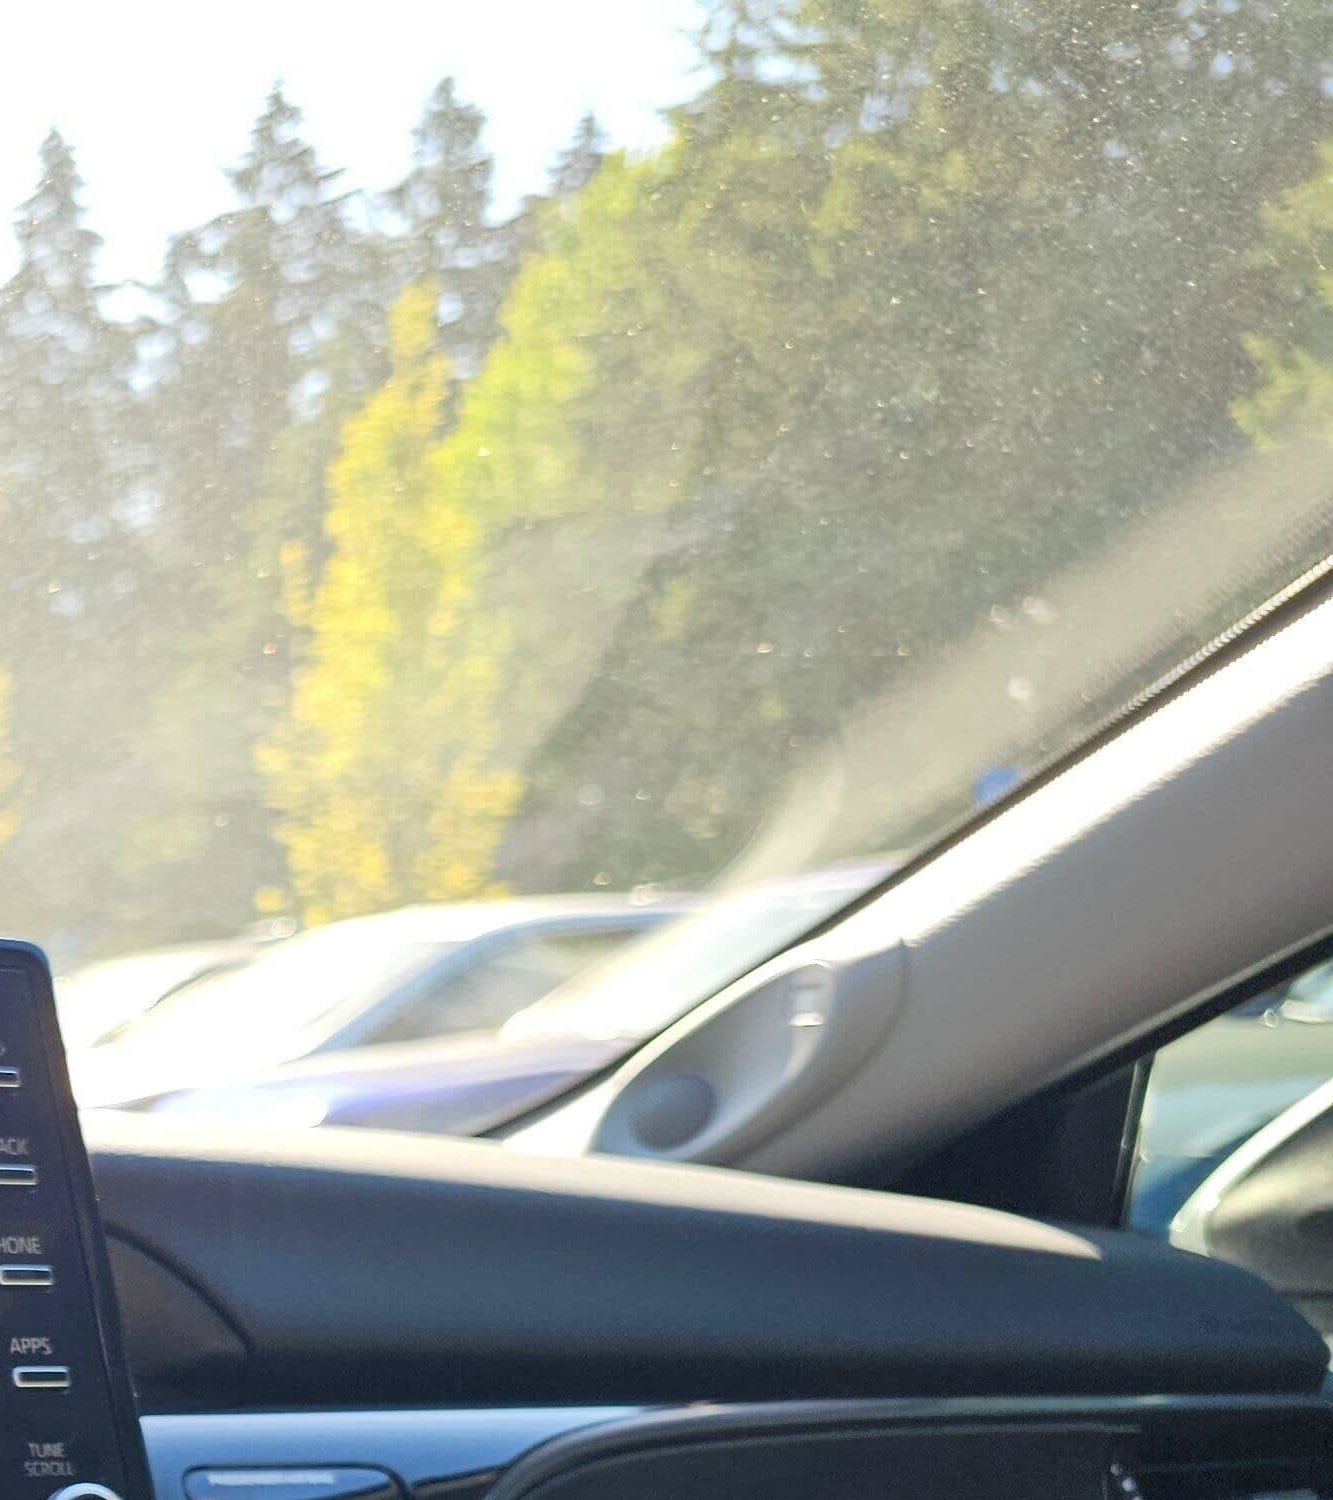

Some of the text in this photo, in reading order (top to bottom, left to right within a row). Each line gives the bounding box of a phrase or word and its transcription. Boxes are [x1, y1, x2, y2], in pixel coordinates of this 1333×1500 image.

[10, 1337, 52, 1356] APPS
[29, 1442, 65, 1458] TUNE
[24, 1461, 74, 1477] SCROLL
